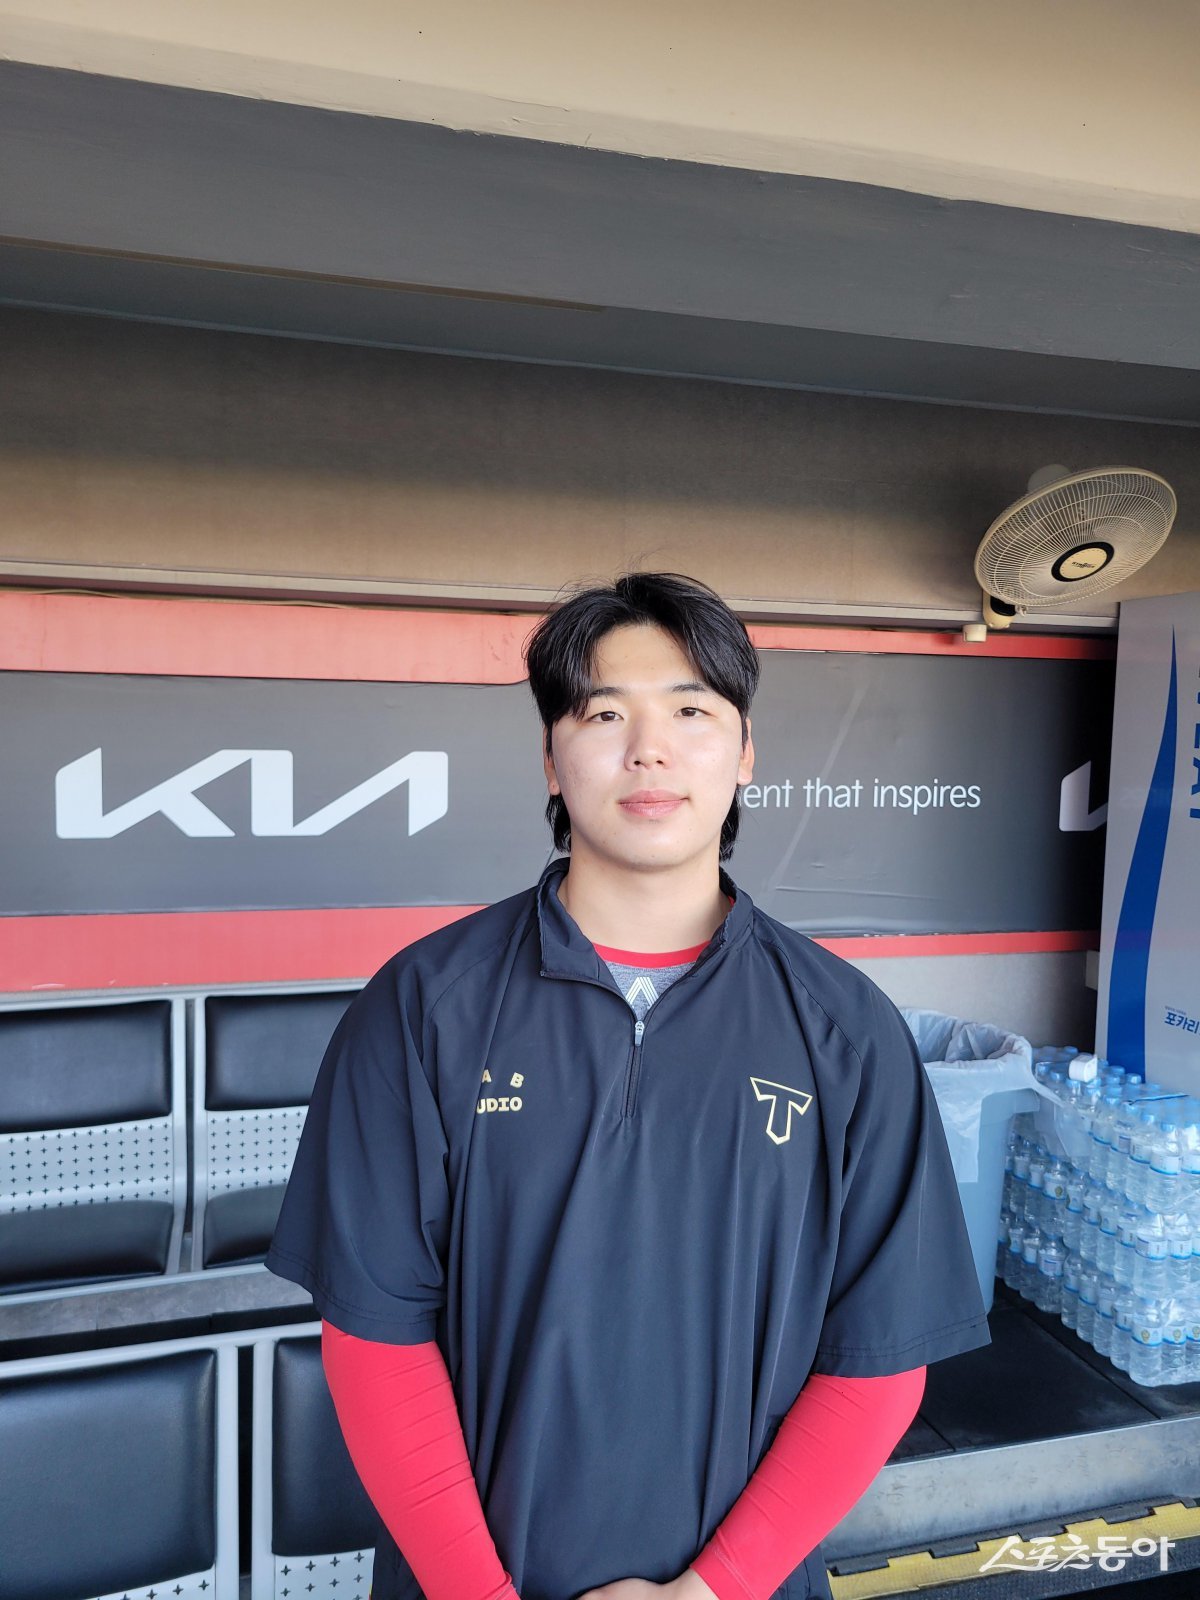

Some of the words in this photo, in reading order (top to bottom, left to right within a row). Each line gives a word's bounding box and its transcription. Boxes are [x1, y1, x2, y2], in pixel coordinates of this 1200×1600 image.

[803, 777, 863, 808] that
[873, 778, 981, 815] inspires
[1164, 1011, 1200, 1034] 포카리
